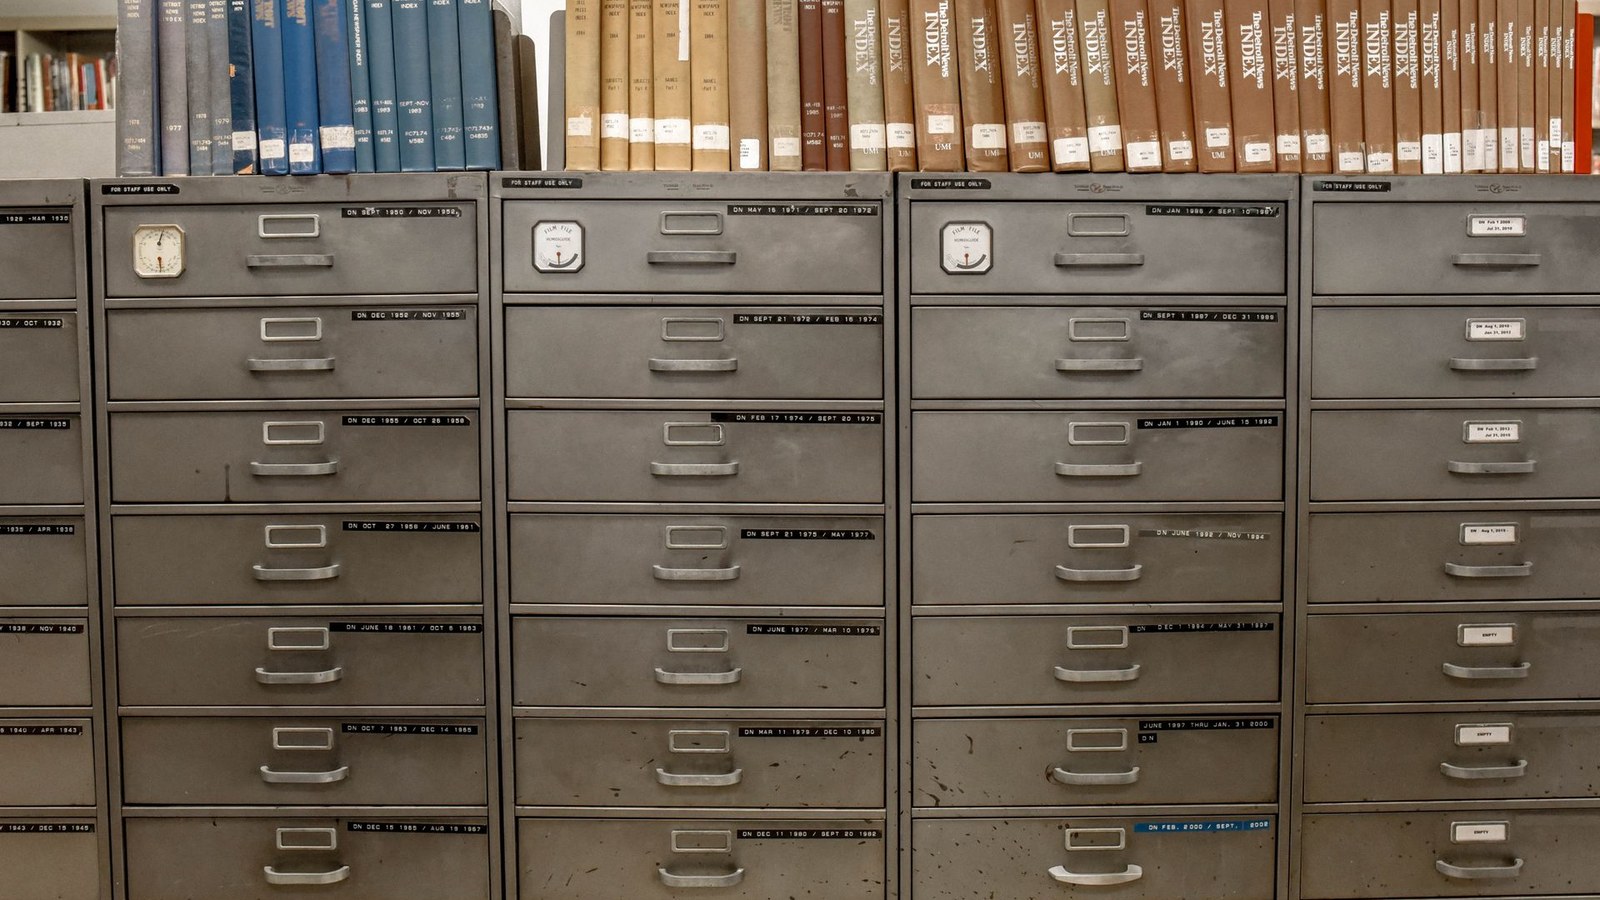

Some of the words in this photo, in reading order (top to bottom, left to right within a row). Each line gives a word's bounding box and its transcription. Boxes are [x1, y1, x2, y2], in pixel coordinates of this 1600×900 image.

[938, 0, 949, 19] The
[1064, 9, 1074, 28] The
[1096, 9, 1106, 28] The
[1136, 9, 1144, 28] The
[1172, 6, 1180, 25] The
[1213, 8, 1223, 28] The
[1252, 10, 1262, 30] The
[1285, 12, 1295, 32] The
[1349, 9, 1358, 29] The
[1379, 9, 1390, 29] The
[1408, 10, 1417, 30] The
[854, 19, 869, 72] INDEX
[887, 17, 903, 72] INDEX
[924, 11, 941, 66] INDEX
[939, 18, 950, 51] Detroit
[971, 17, 988, 72] INDEX
[1012, 23, 1030, 77] INDEX
[1051, 20, 1069, 75] INDEX
[1065, 27, 1077, 61] Detroit
[1084, 20, 1102, 75] INDEX
[1098, 27, 1110, 61] Detroit
[1124, 20, 1141, 75] INDEX
[1137, 28, 1148, 61] Detroit
[1160, 16, 1177, 70] INDEX
[1173, 24, 1183, 58] Detroit
[1201, 21, 1217, 76] INDEX
[1214, 28, 1226, 62] Detroit
[1253, 29, 1264, 63] Detroit
[1286, 31, 1297, 66] Detroit
[1335, 21, 1351, 76] INDEX
[1350, 28, 1359, 63] Detroit
[1366, 22, 1382, 77] INDEX
[1380, 28, 1390, 64] Detroit
[1394, 22, 1410, 77] INDEX
[1408, 29, 1419, 64] Detroit
[1422, 22, 1434, 77] INDEX
[940, 50, 951, 78] News
[1240, 24, 1257, 79] INDEX
[1273, 25, 1290, 80] INDEX
[1302, 25, 1318, 80] INDEX
[1068, 61, 1078, 86] News
[1101, 61, 1111, 86] News
[1139, 61, 1149, 87] News
[1175, 57, 1184, 83] News
[1217, 61, 1227, 88] News
[1255, 62, 1265, 89] News
[1288, 65, 1297, 91] News
[1351, 62, 1360, 88] News
[1381, 63, 1391, 89] News
[1409, 63, 1419, 89] News
[935, 143, 952, 151] UMI
[1028, 151, 1044, 159] UMI
[1211, 151, 1226, 159] UMI
[544, 225, 557, 234] FILM
[560, 225, 573, 234] FILE
[951, 226, 965, 235] FILM
[968, 226, 980, 234] FILE
